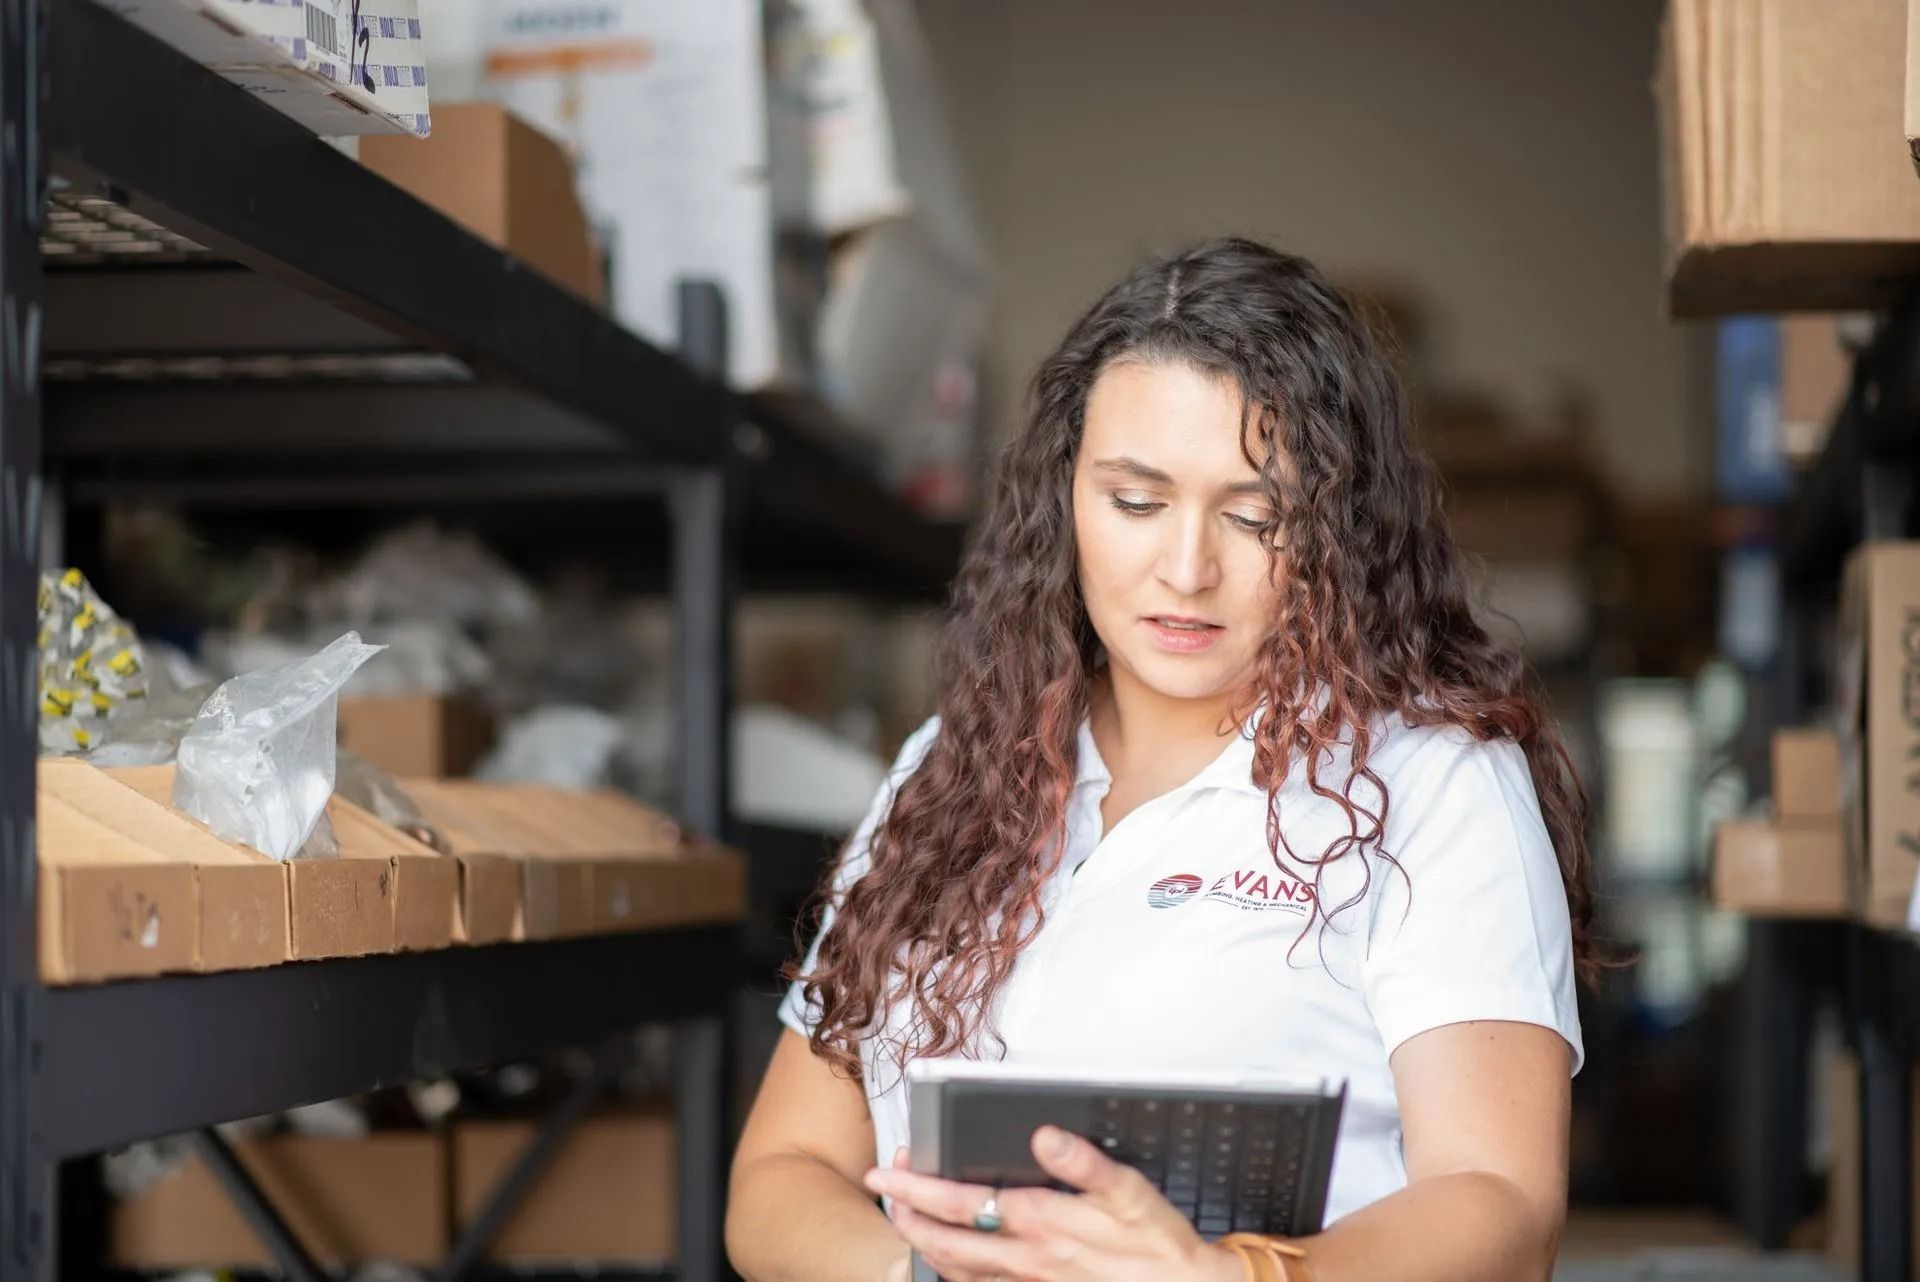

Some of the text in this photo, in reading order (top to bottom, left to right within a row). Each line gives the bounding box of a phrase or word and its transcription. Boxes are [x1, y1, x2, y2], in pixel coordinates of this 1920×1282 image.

[1209, 870, 1317, 902] EVANS
[1235, 896, 1261, 906] HEATING
[1269, 902, 1307, 911] MECHANICAL
